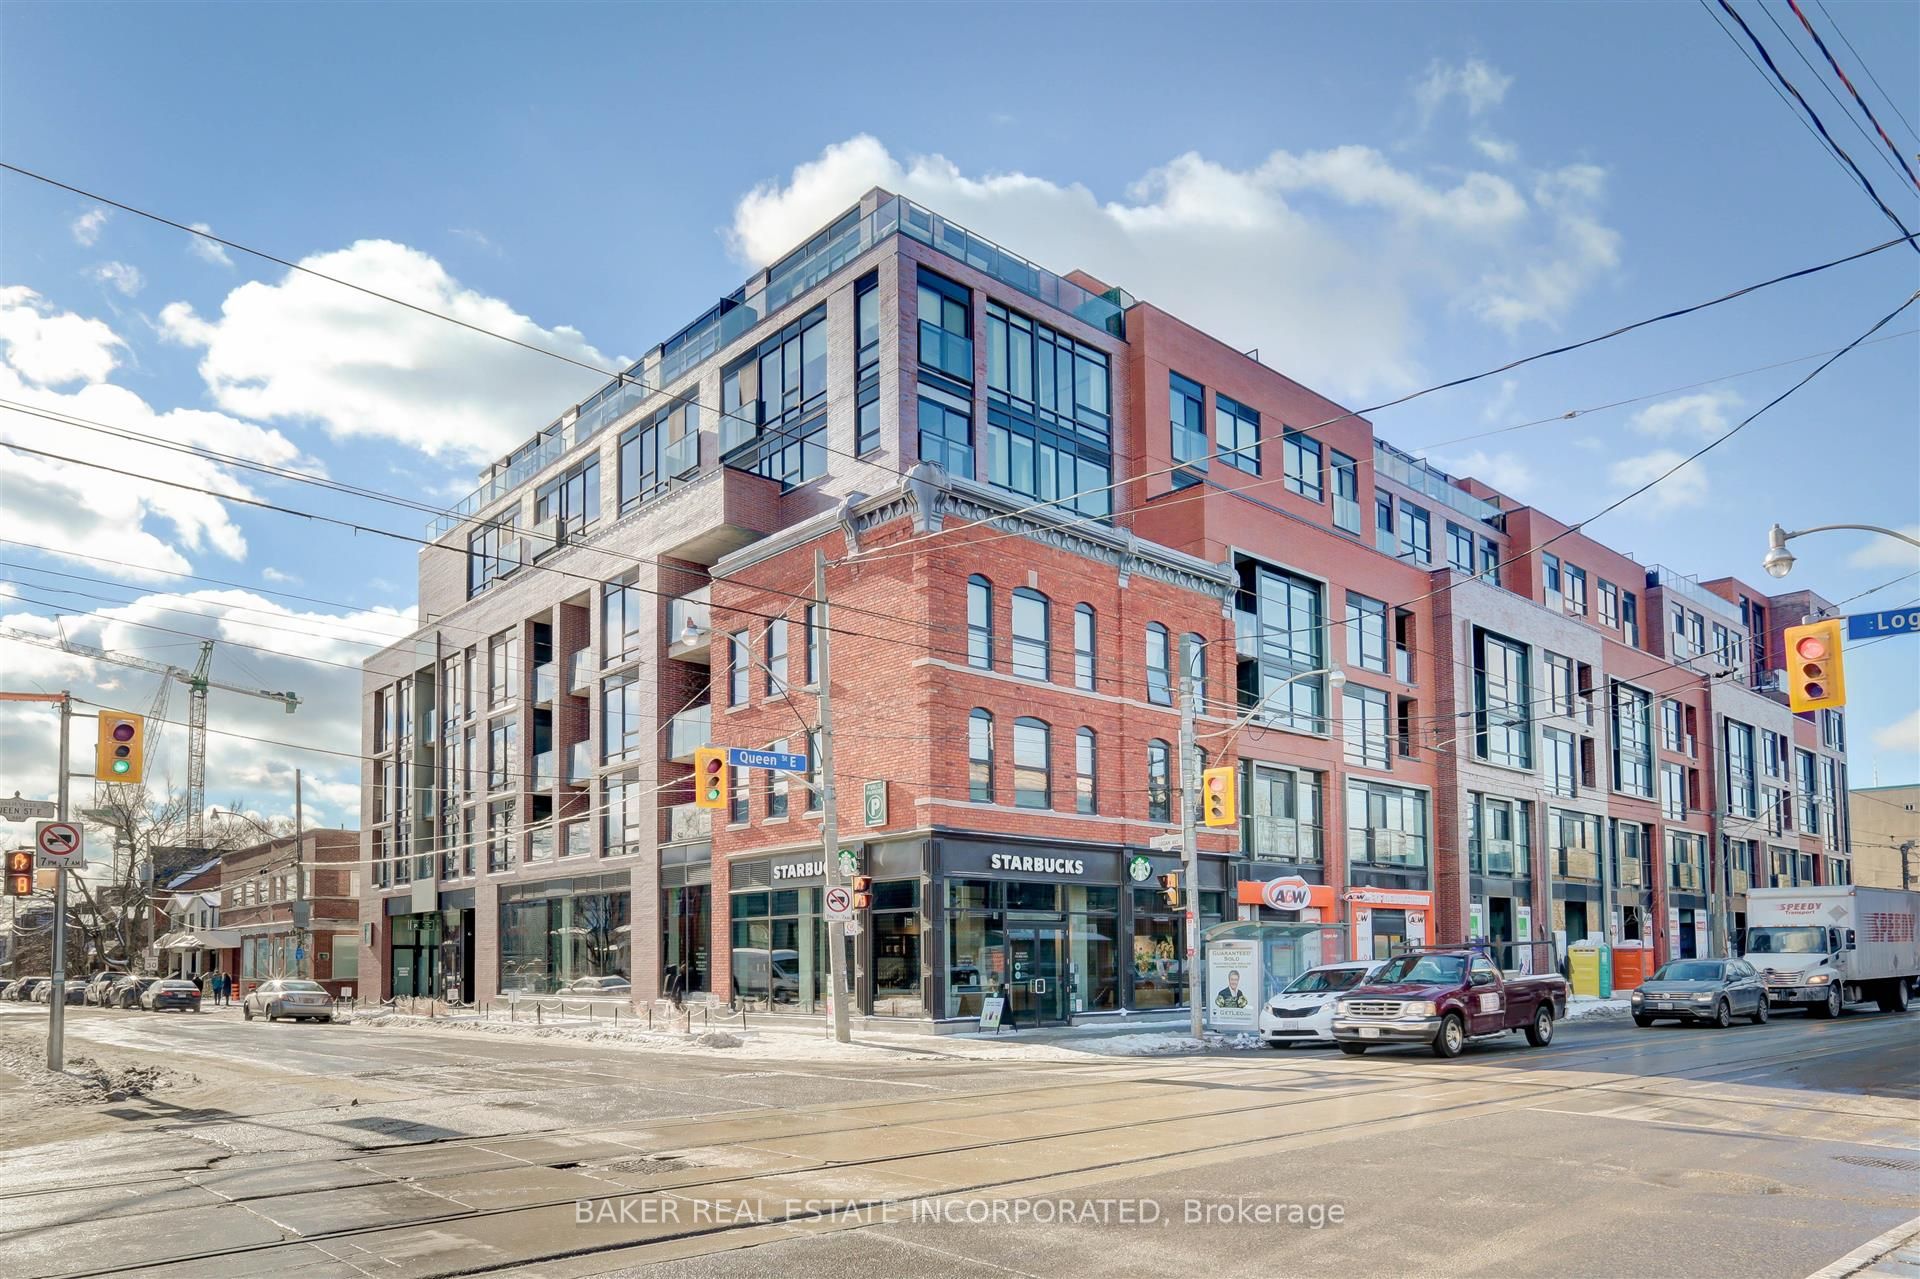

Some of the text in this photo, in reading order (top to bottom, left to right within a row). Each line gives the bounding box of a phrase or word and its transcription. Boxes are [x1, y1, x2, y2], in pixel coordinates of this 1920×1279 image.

[1877, 612, 1920, 631] Log
[740, 751, 777, 766] Queen
[790, 756, 797, 768] E
[24, 807, 32, 815] ST
[871, 798, 880, 816] P
[773, 861, 827, 880] STARBU
[991, 853, 1084, 875] STARBUCKS
[1275, 889, 1307, 904] A&W
[1779, 902, 1823, 911] SPEEDY
[1868, 912, 1916, 943] SPEEDY
